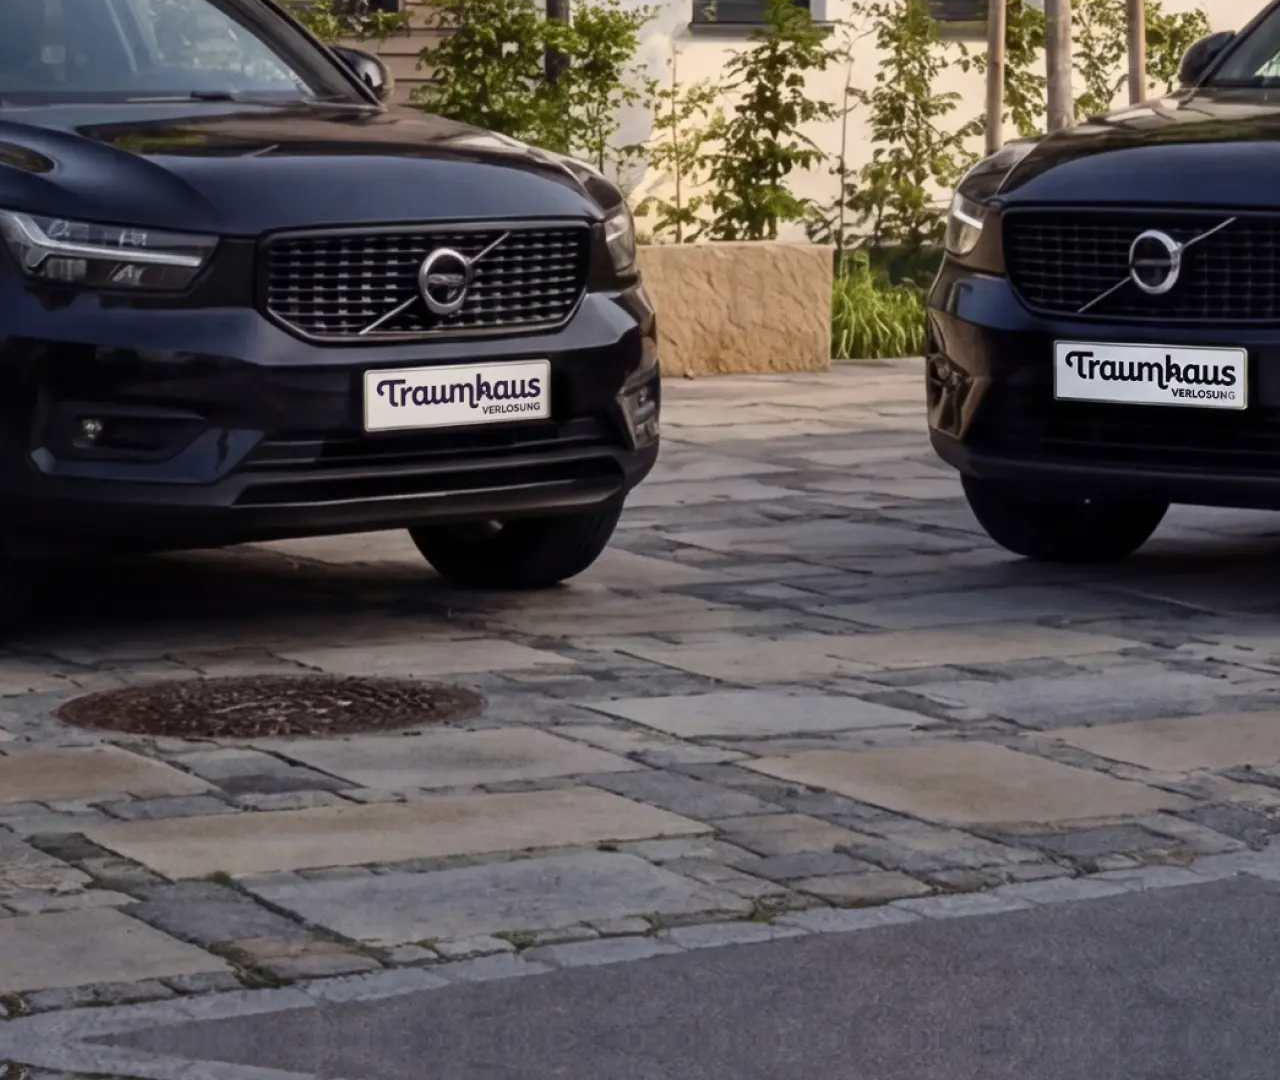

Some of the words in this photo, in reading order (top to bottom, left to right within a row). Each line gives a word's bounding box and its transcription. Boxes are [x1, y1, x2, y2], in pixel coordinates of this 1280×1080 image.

[1065, 351, 1236, 390] Traumhaus
[376, 373, 541, 409] Traumhaus
[1171, 387, 1235, 400] VERLOSUNG
[482, 402, 541, 415] VERLOSUNG
